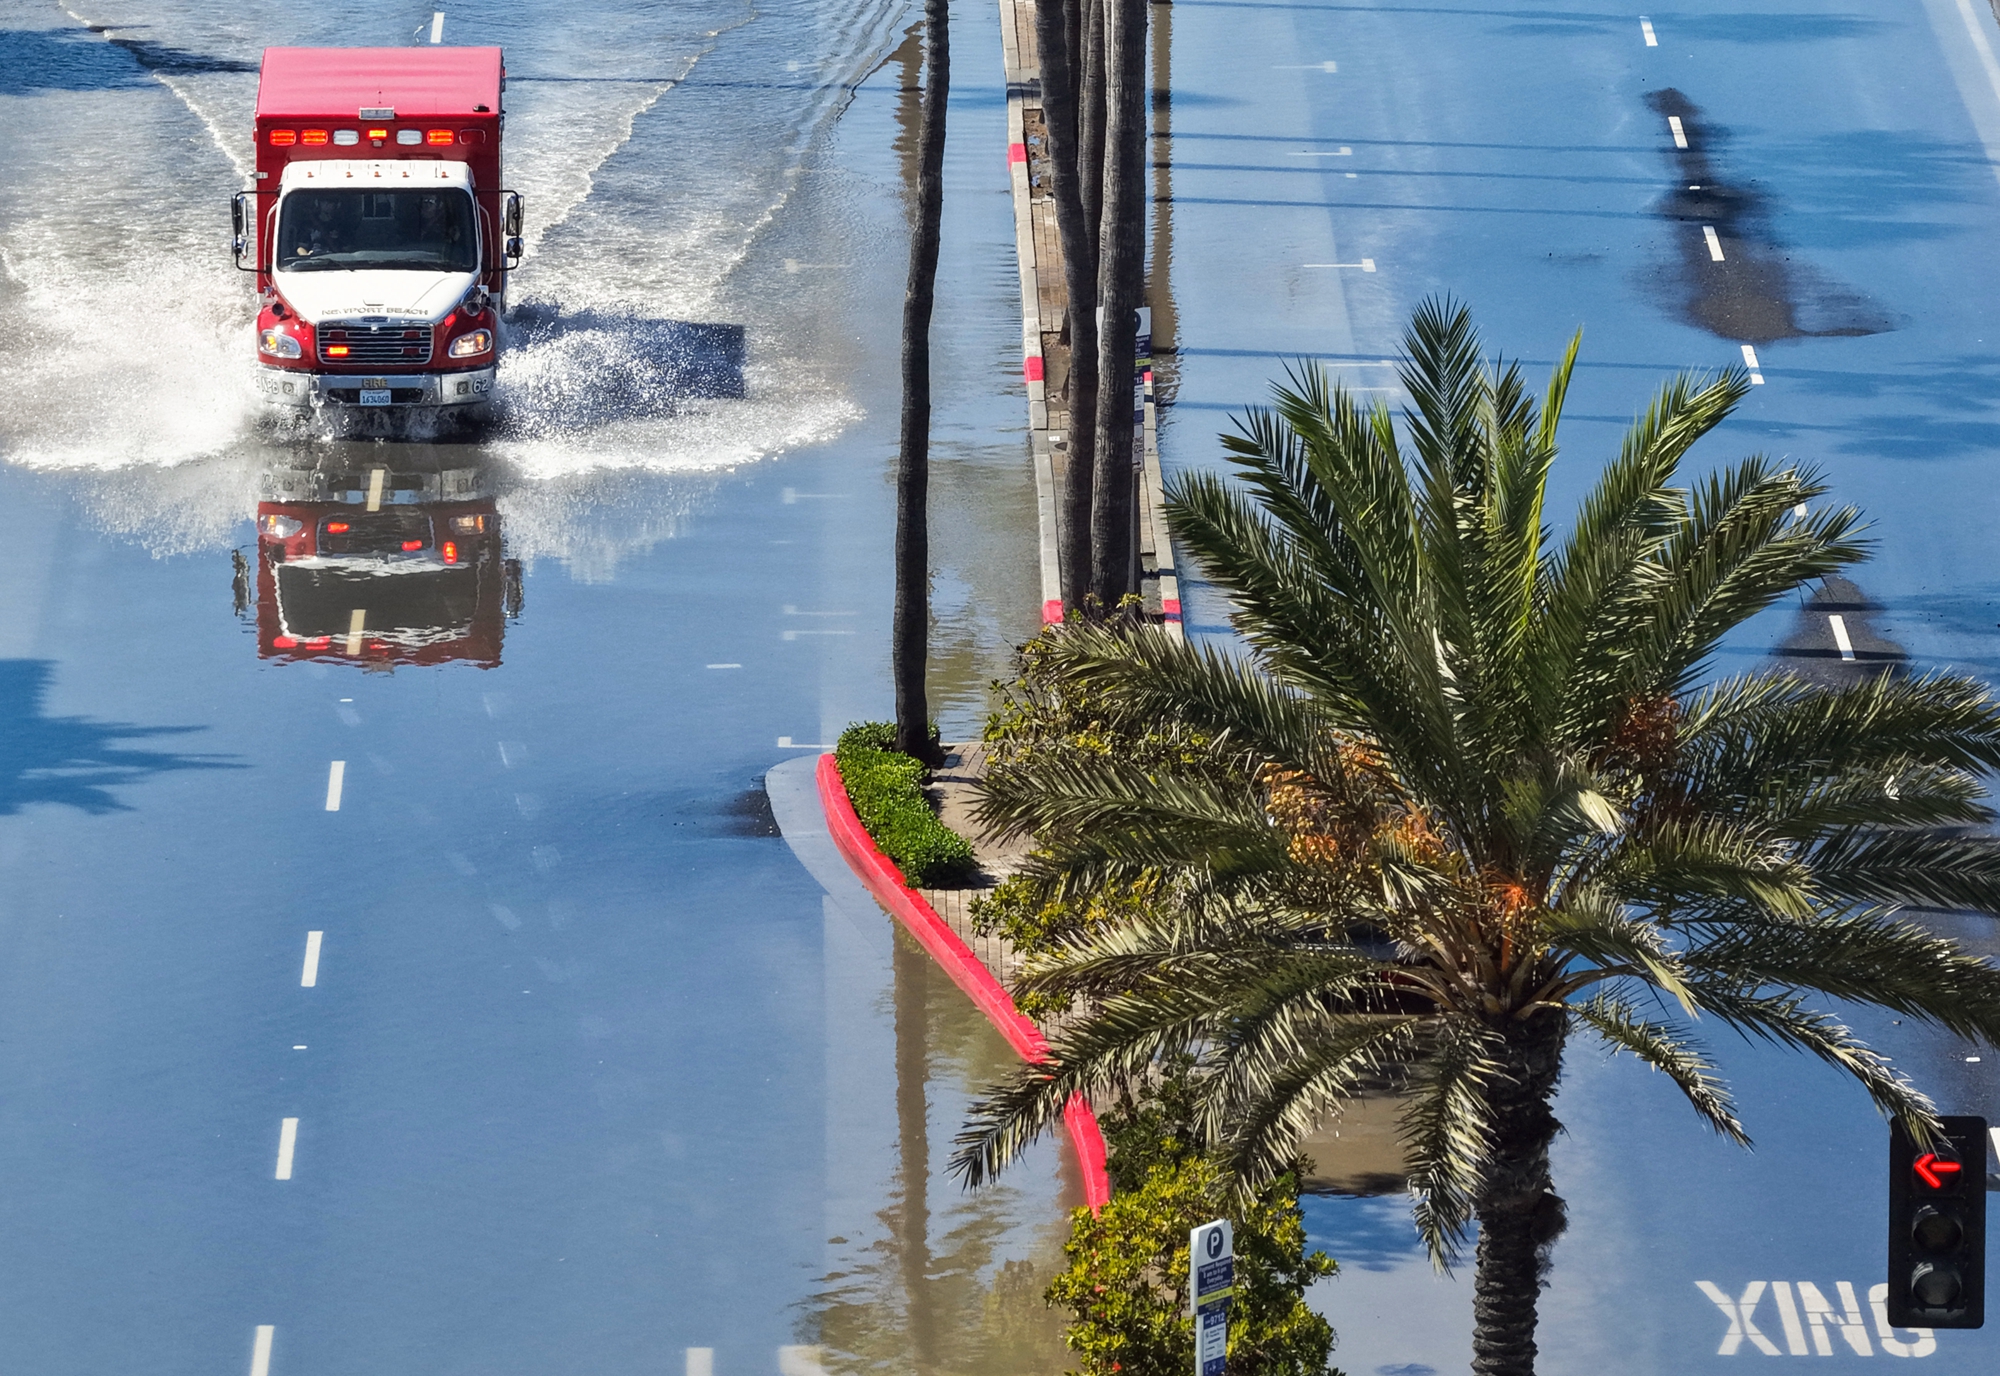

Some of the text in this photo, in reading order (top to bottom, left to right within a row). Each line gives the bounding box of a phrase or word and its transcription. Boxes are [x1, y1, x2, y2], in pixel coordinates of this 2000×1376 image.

[386, 307, 429, 315] BEACH
[362, 378, 388, 388] FIRE
[472, 378, 489, 394] 62
[1211, 1232, 1220, 1255] P
[1210, 1312, 1225, 1326] 9712
